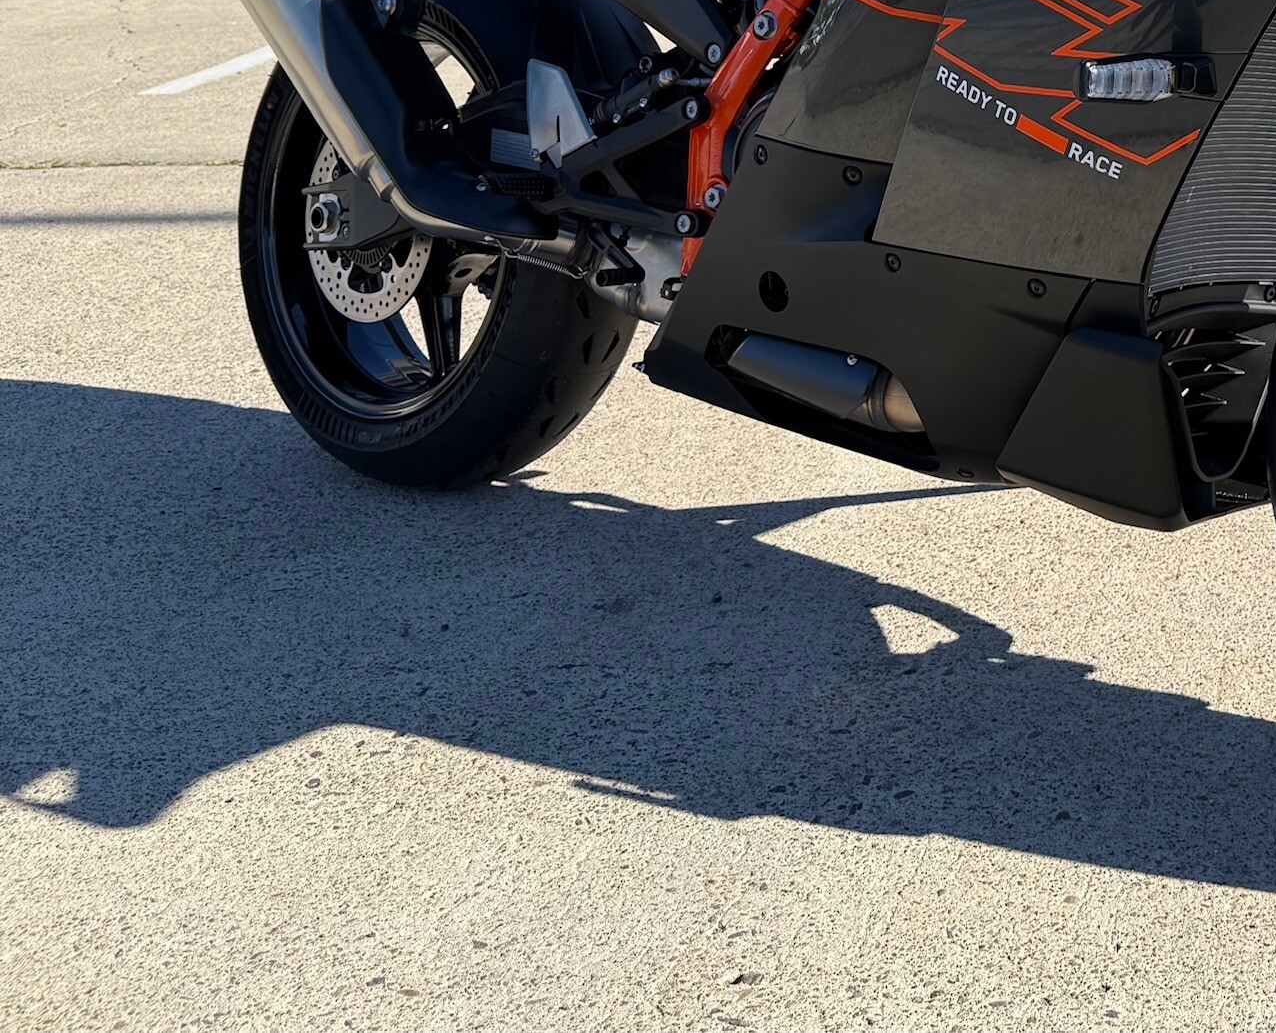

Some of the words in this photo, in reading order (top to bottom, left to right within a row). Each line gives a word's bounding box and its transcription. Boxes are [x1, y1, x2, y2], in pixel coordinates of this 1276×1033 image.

[934, 64, 993, 111] READY
[993, 100, 1018, 126] TO
[1067, 142, 1124, 180] RACE
